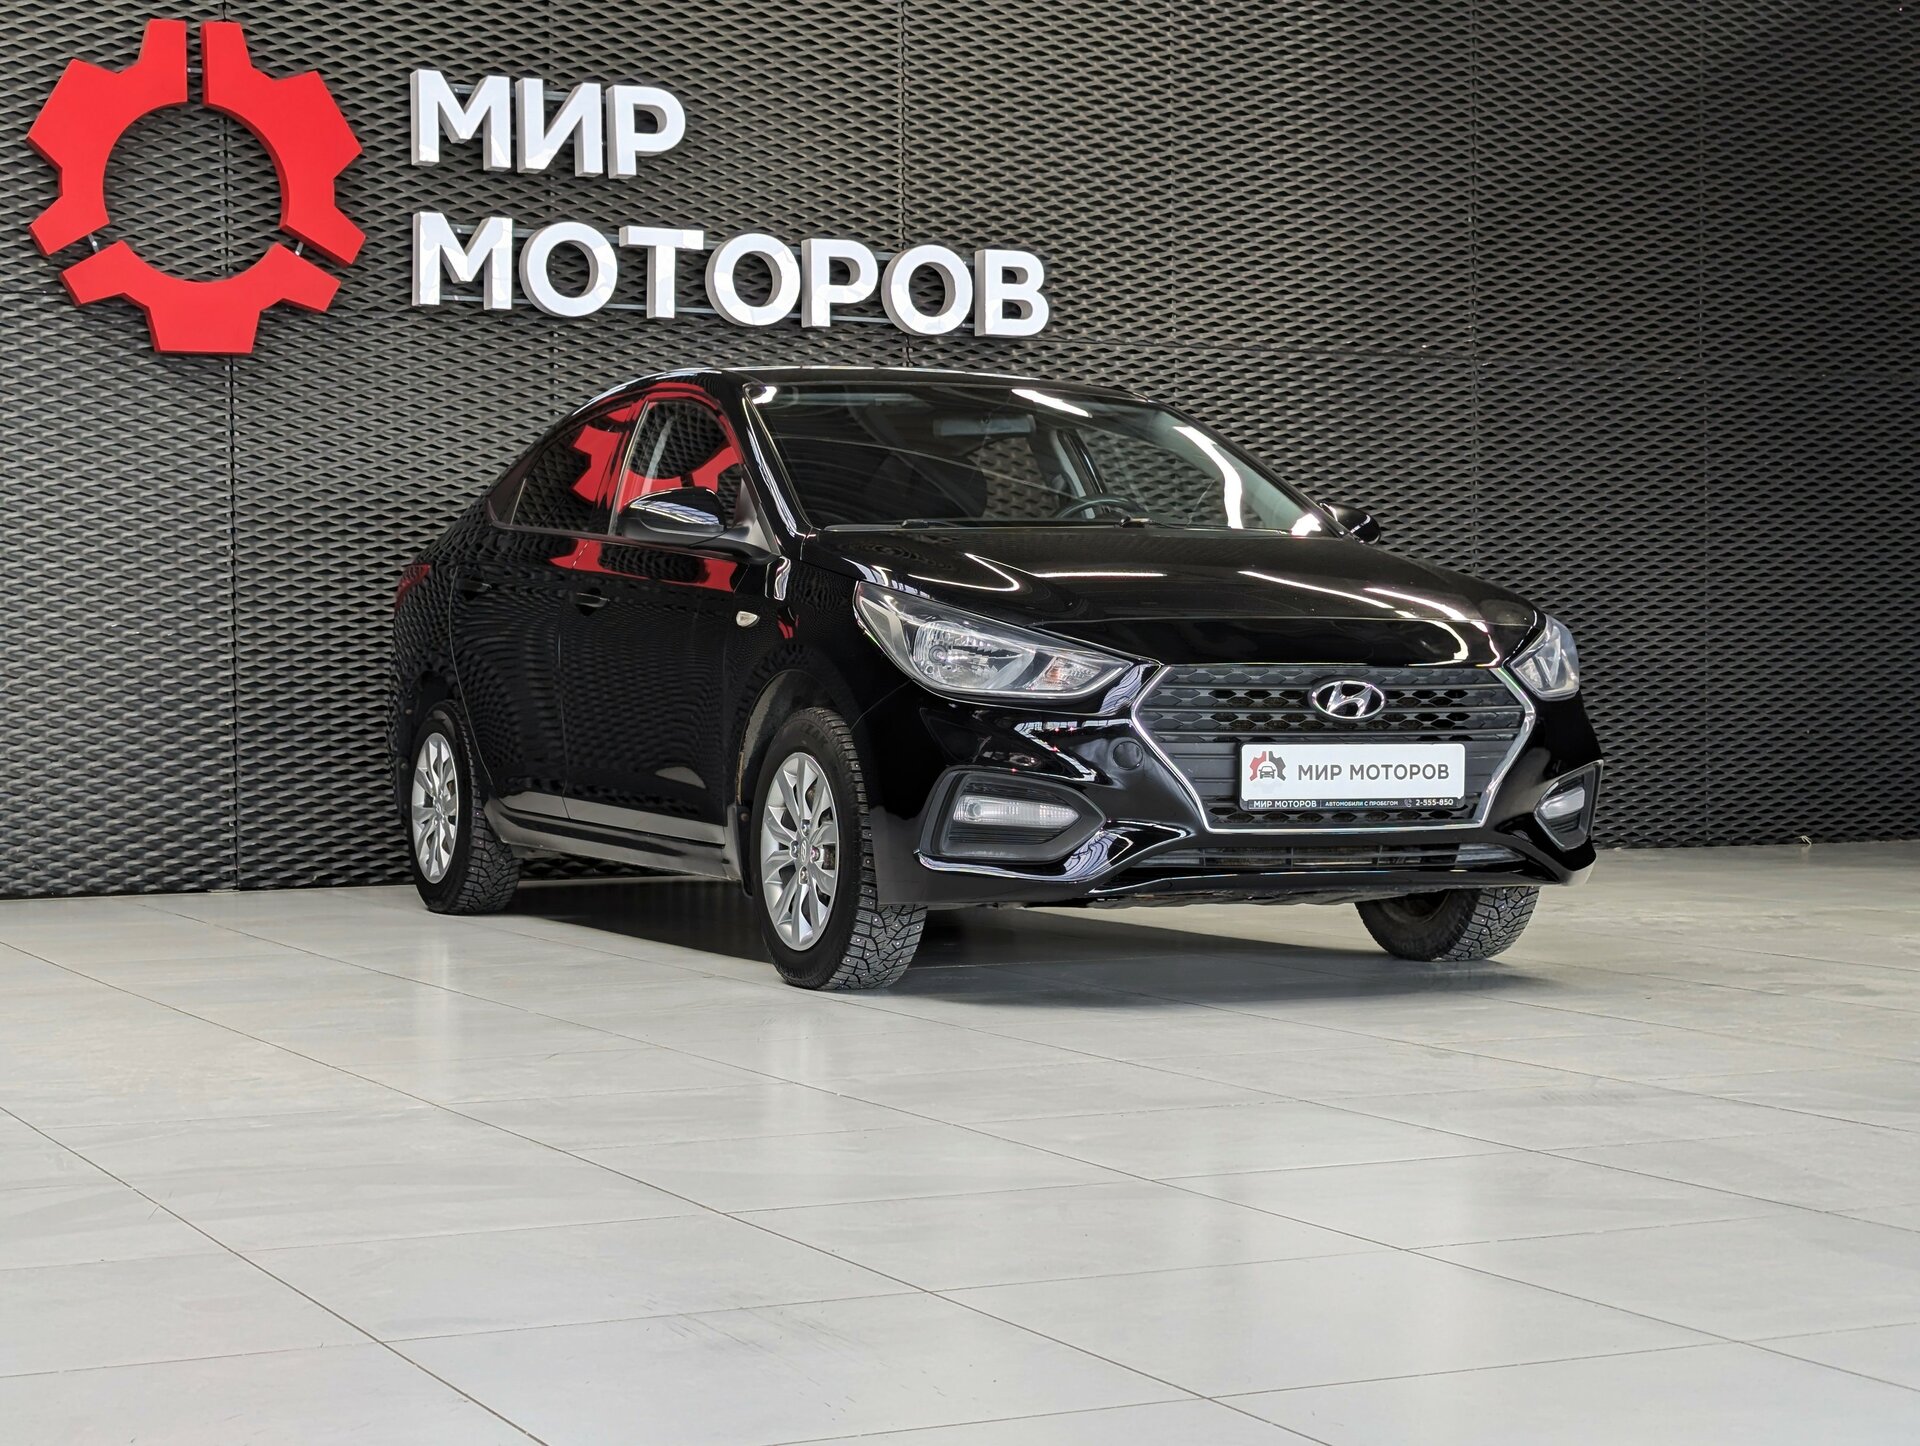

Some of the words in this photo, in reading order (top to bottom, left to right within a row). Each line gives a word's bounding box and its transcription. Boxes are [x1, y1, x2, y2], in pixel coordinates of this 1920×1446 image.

[409, 68, 686, 179] МИР
[411, 210, 1050, 338] МОТОРОВ
[1298, 764, 1342, 781] МИР
[1349, 763, 1449, 780] МОТОРОВ
[1253, 800, 1272, 808] МИР
[1274, 800, 1317, 808] МОТОРОВ
[1415, 798, 1454, 806] 2-555-850
